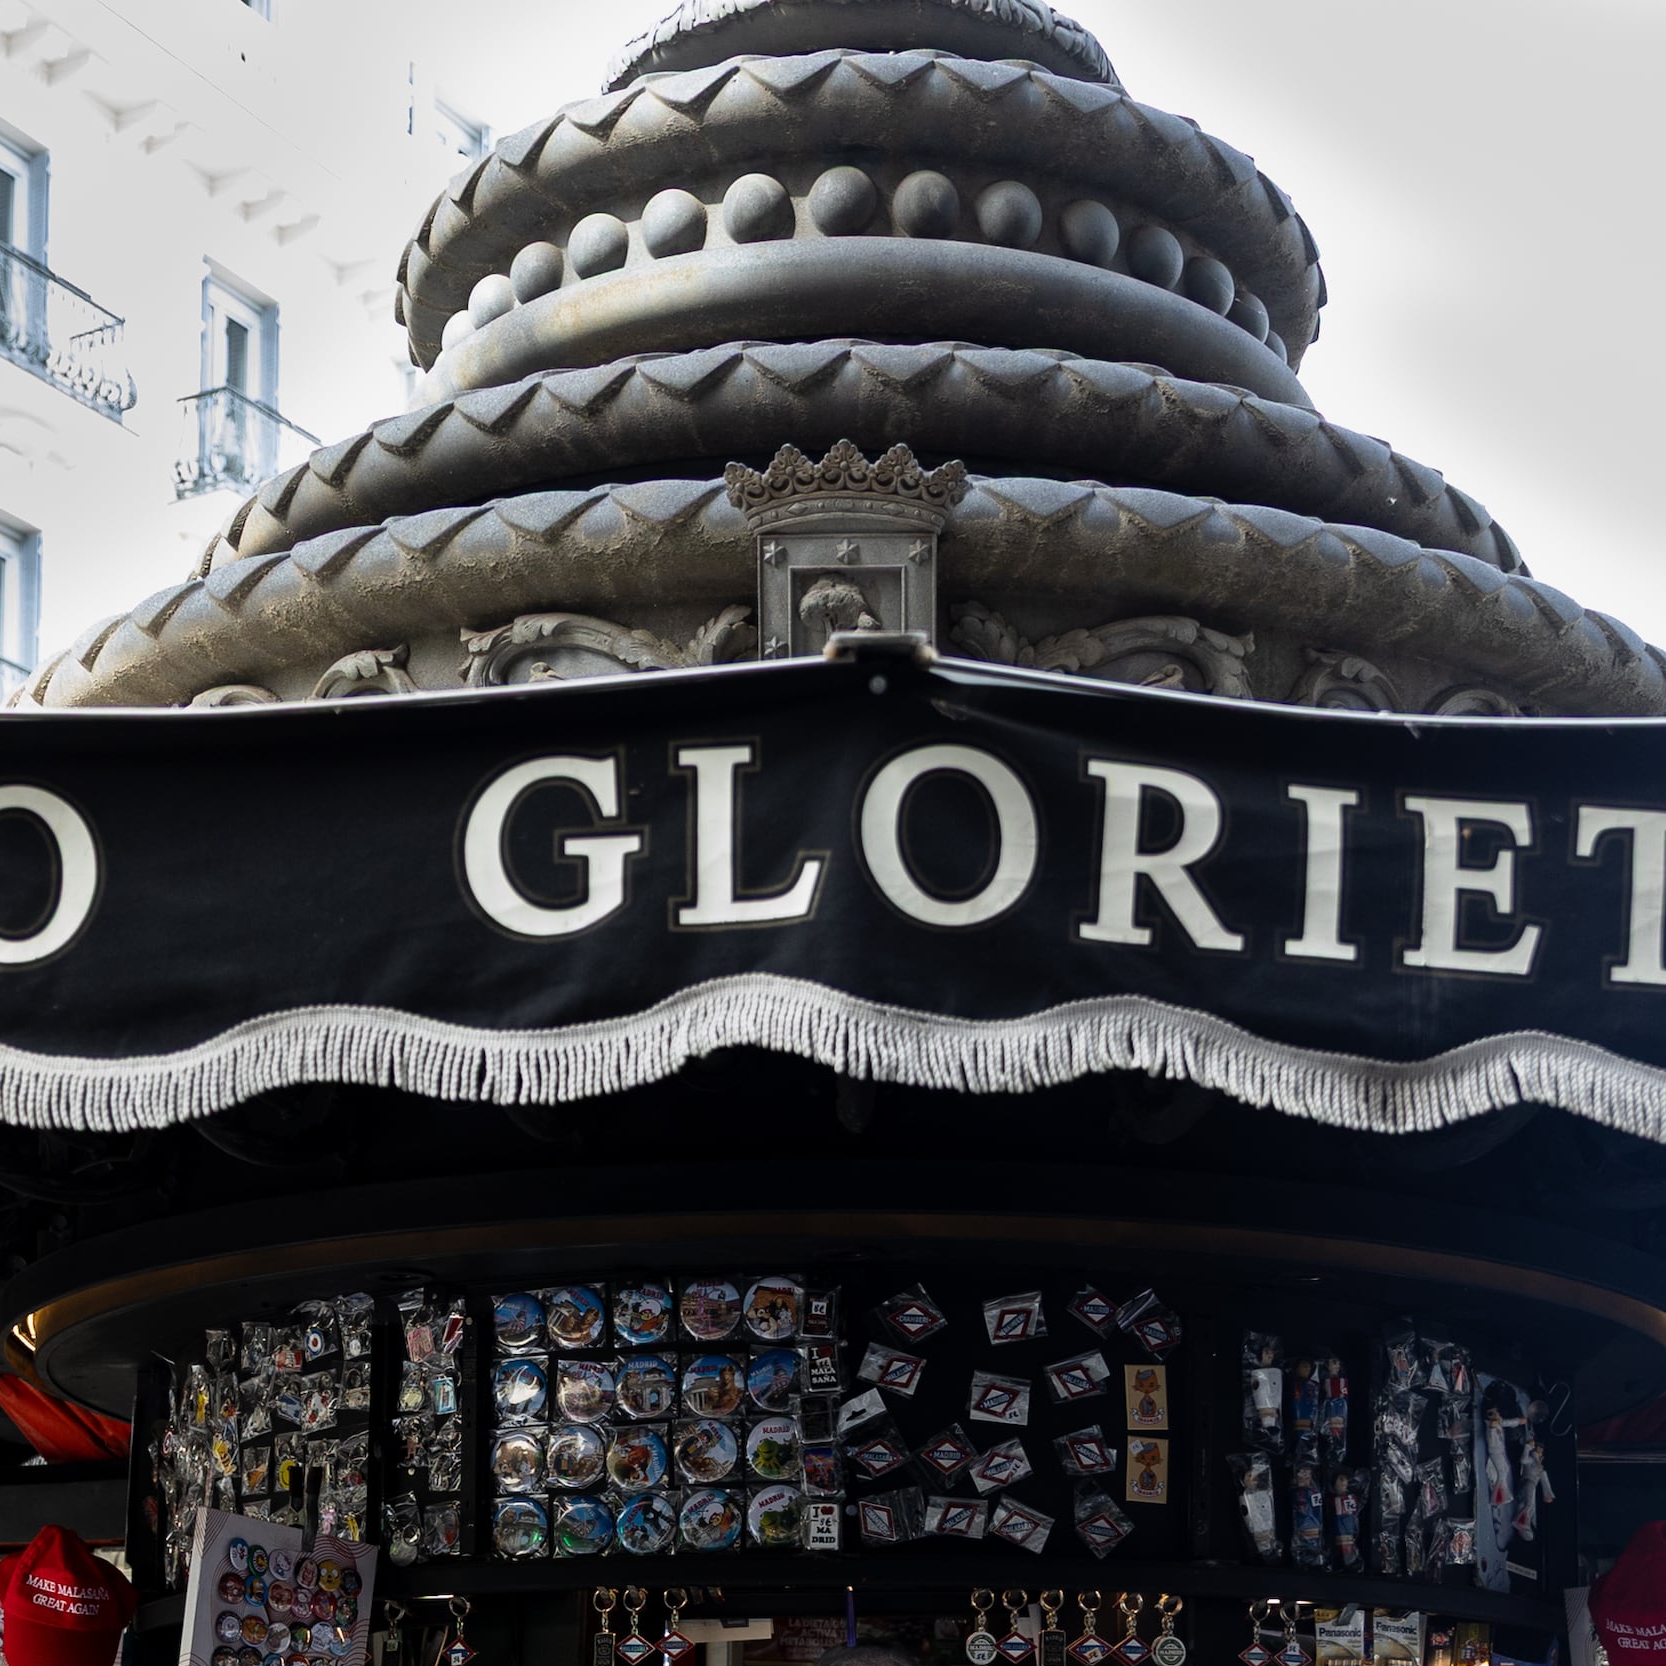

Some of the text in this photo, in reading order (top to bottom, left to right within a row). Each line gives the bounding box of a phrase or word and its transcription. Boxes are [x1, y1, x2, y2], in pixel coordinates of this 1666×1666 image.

[25, 1574, 56, 1595] MAKE
[33, 1594, 99, 1617] GREAT AGAIN
[1318, 1626, 1362, 1641] Panasonic
